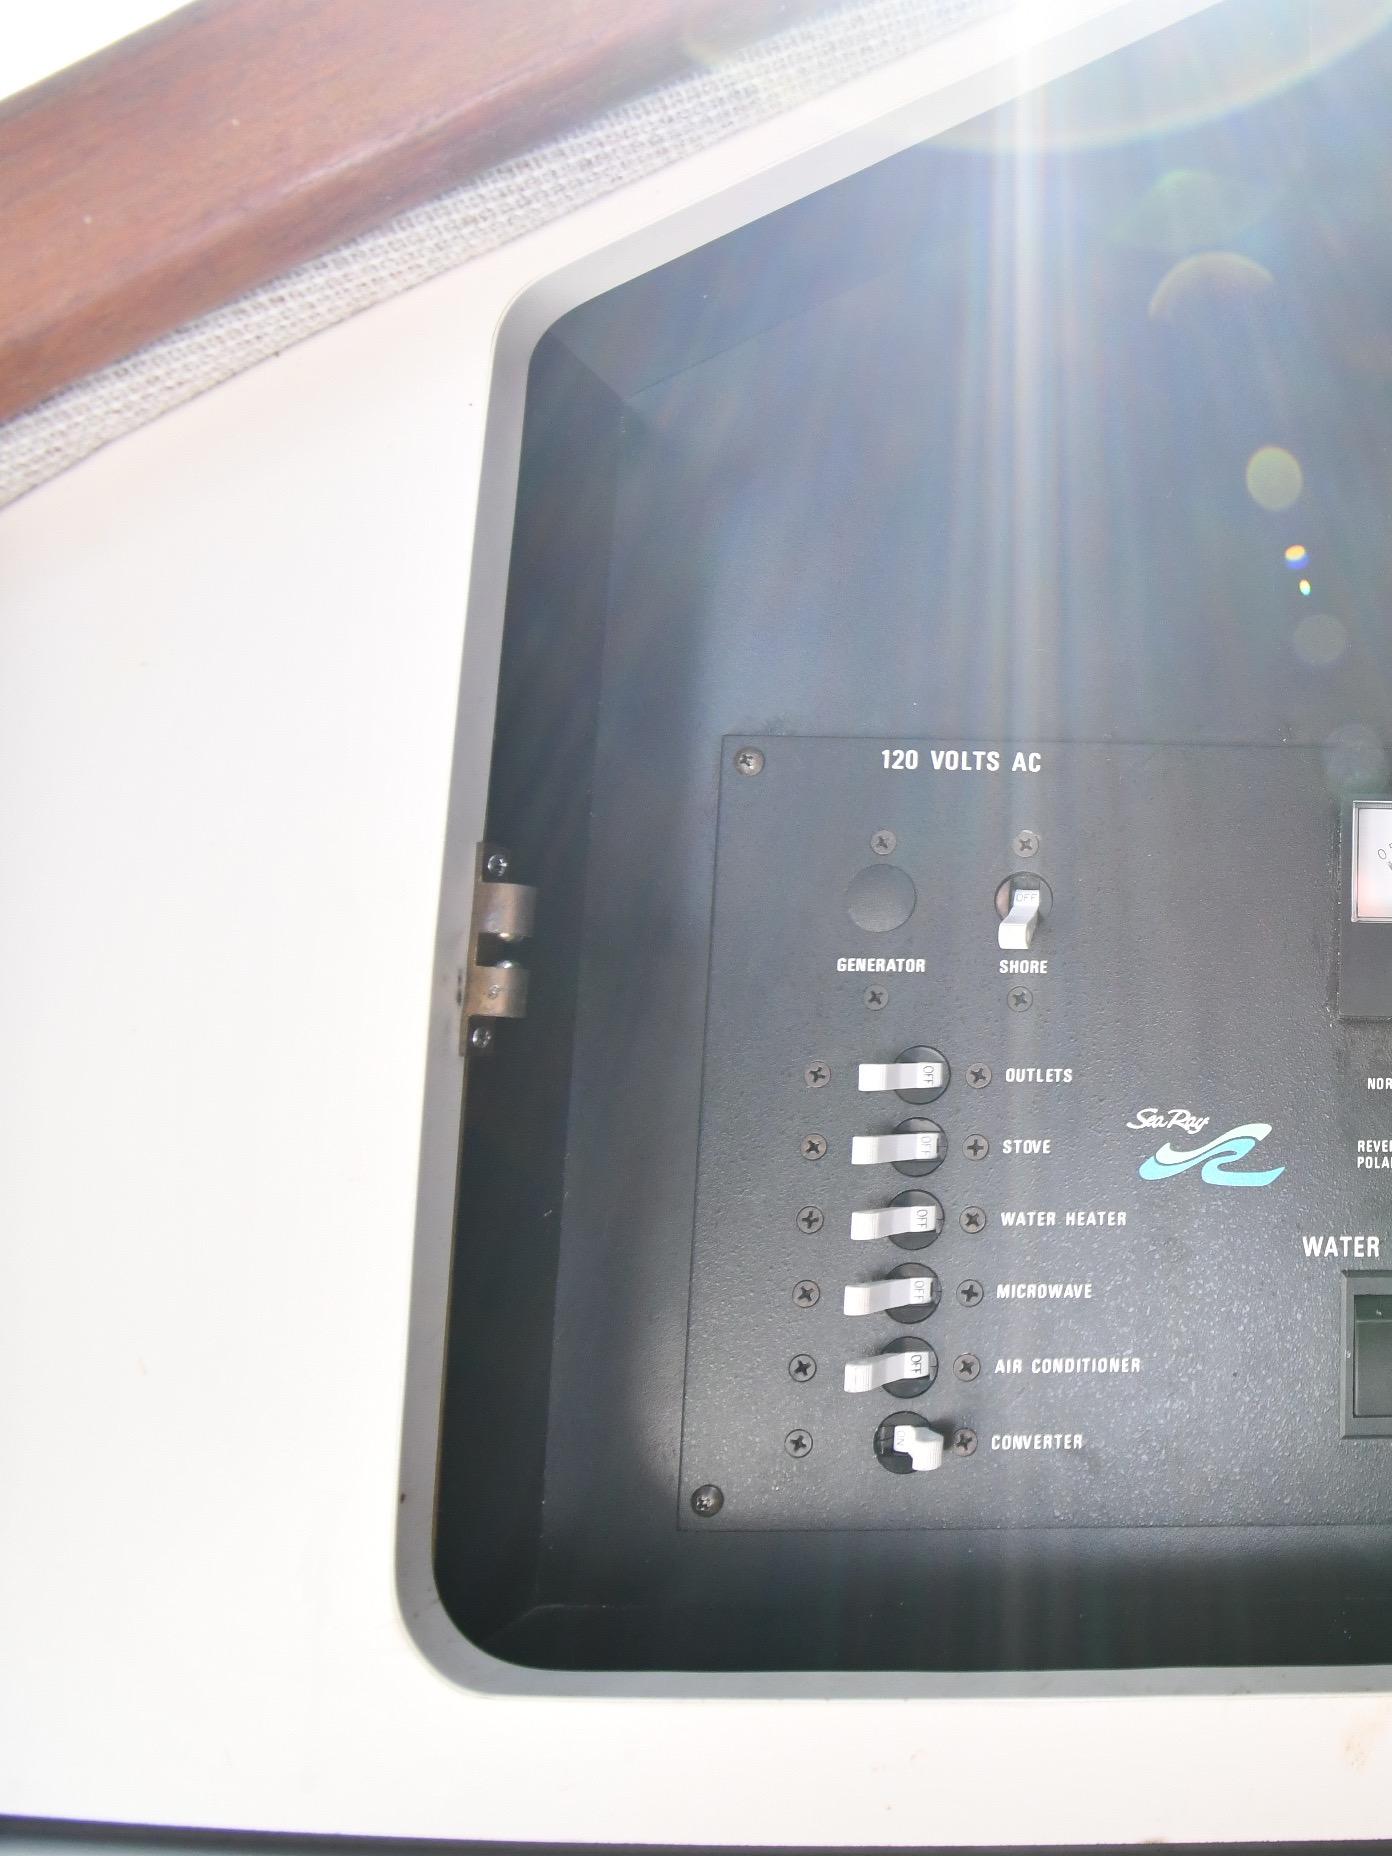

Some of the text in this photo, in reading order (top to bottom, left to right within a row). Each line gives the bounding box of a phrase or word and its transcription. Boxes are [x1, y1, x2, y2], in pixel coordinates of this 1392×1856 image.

[881, 749, 1042, 773] 120 VOLTS AC
[1377, 848, 1387, 860] 0
[1016, 893, 1038, 902] OFF
[836, 957, 926, 973] GENERATOR
[999, 959, 1048, 974] SHORE
[922, 1065, 935, 1087] OFF
[1005, 1067, 1073, 1083] OUTLETS
[1126, 1108, 1210, 1135] Sea Ray
[1002, 1139, 1051, 1155] STOVE
[916, 1209, 928, 1229] OFF
[1000, 1211, 1127, 1227] WATER HEATER
[1302, 1235, 1380, 1258] WATER
[914, 1280, 925, 1302] OFF
[996, 1283, 1092, 1299] MICROWAVE
[910, 1354, 922, 1375] OFF
[994, 1357, 1141, 1374] AIR CONDITIONER
[991, 1433, 1083, 1450] CONVERTER
